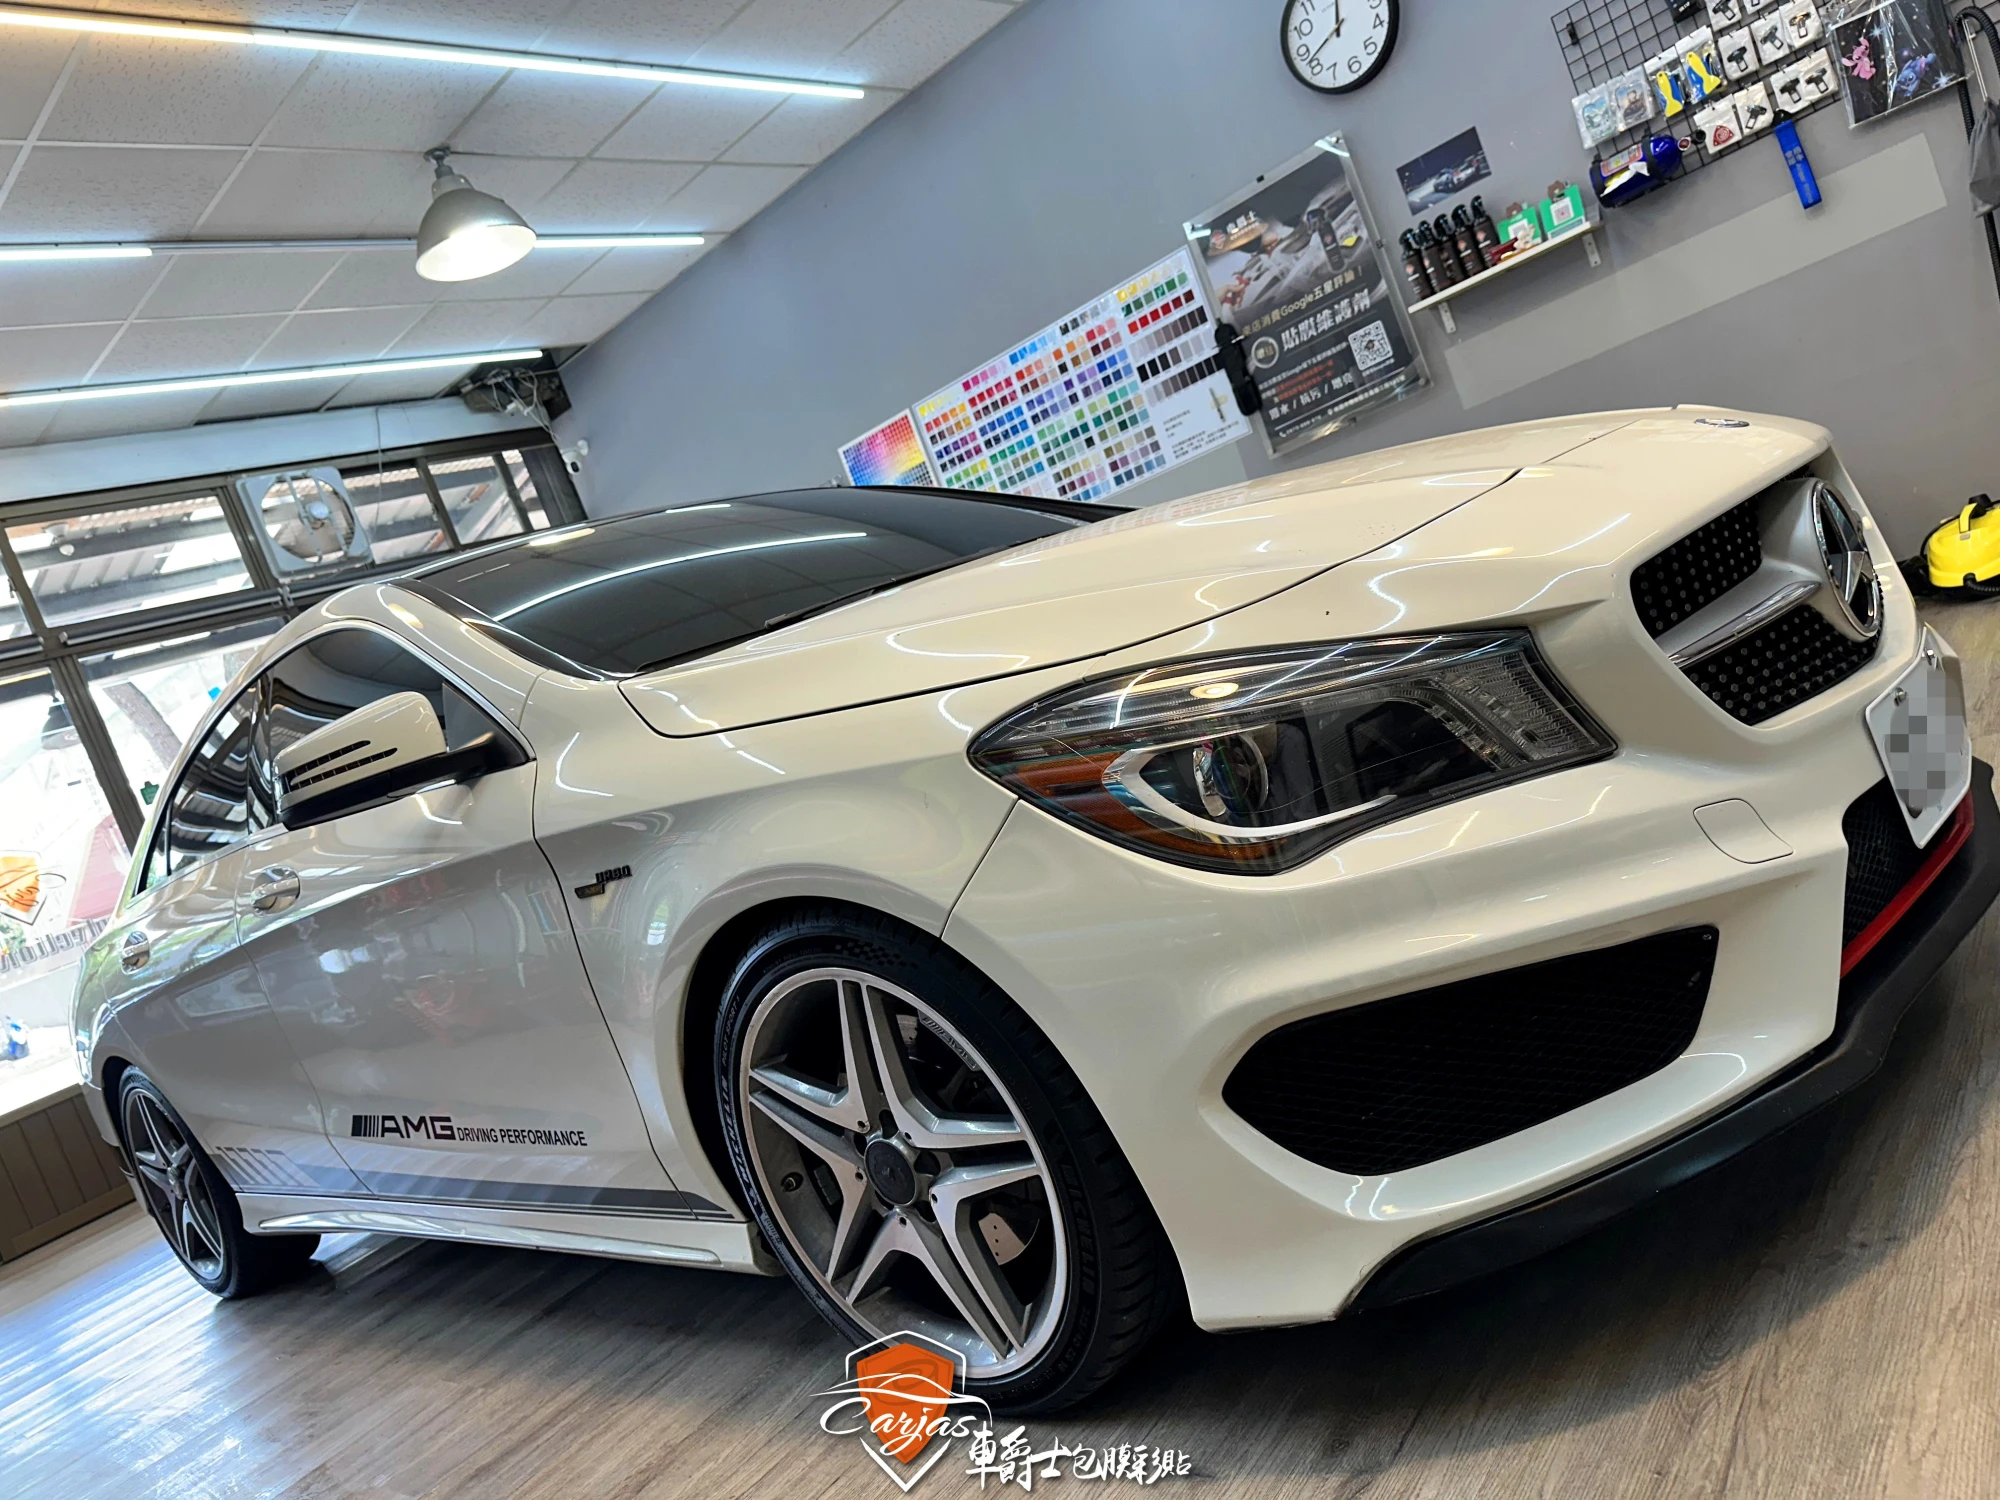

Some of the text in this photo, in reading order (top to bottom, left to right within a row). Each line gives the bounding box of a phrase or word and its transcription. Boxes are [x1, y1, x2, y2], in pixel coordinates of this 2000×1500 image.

[1293, 18, 1313, 40] 10
[1372, 12, 1385, 29] 4
[1296, 43, 1311, 62] 9
[1363, 36, 1378, 56] 5
[1309, 57, 1324, 76] 8
[1326, 61, 1337, 81] 7
[1347, 55, 1362, 74] 6
[457, 1127, 498, 1144] DRIVING
[499, 1128, 588, 1147] PERFORMANCE
